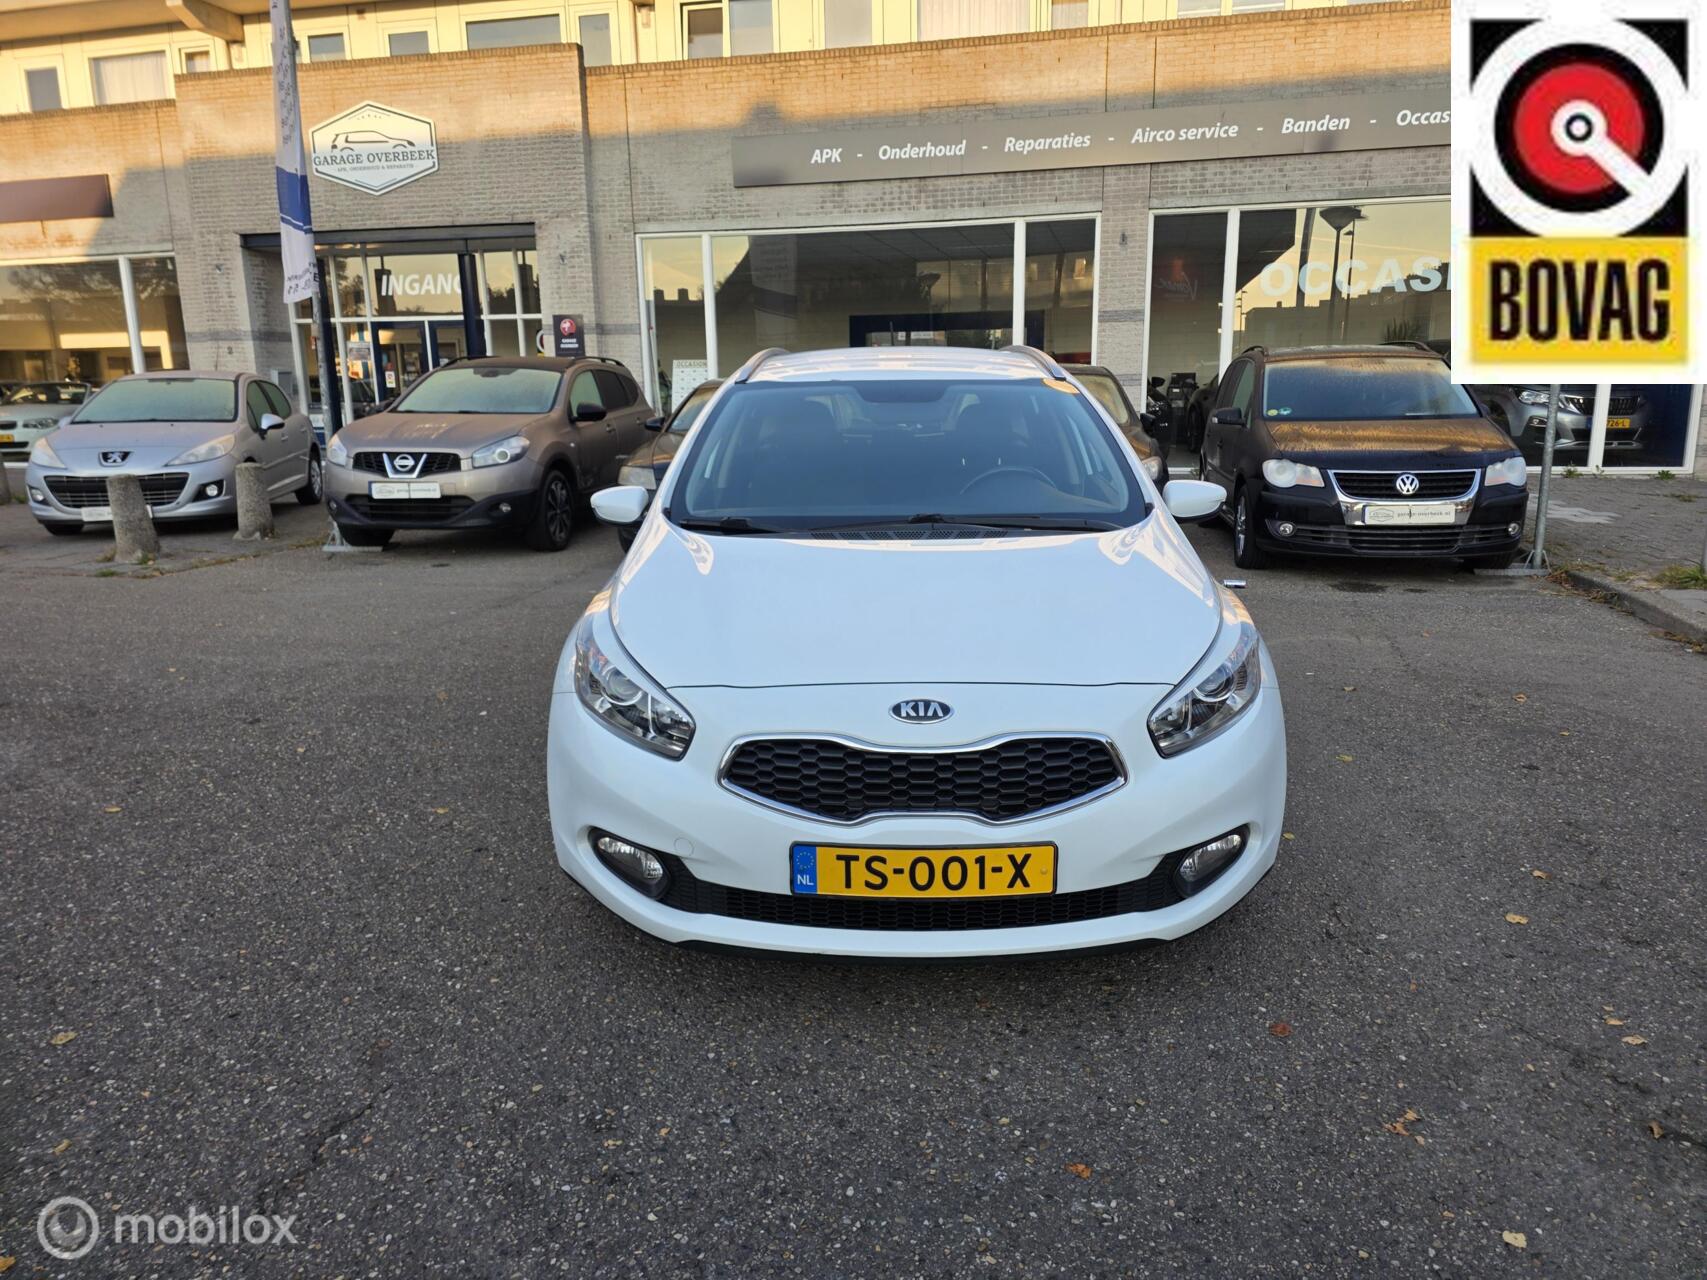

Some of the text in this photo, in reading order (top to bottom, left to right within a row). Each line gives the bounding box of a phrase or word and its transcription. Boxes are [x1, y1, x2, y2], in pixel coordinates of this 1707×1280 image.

[811, 148, 842, 164] APK
[879, 140, 966, 160] Onderhoud
[1004, 132, 1091, 154] Reparaties
[1131, 127, 1175, 144] Airco
[1178, 123, 1239, 140] service
[1281, 115, 1350, 134] Banden
[313, 149, 436, 167] GARAGE OVERBEEK
[900, 702, 943, 717] KIA
[797, 874, 814, 886] NL
[836, 853, 1032, 891] TS-001-X
